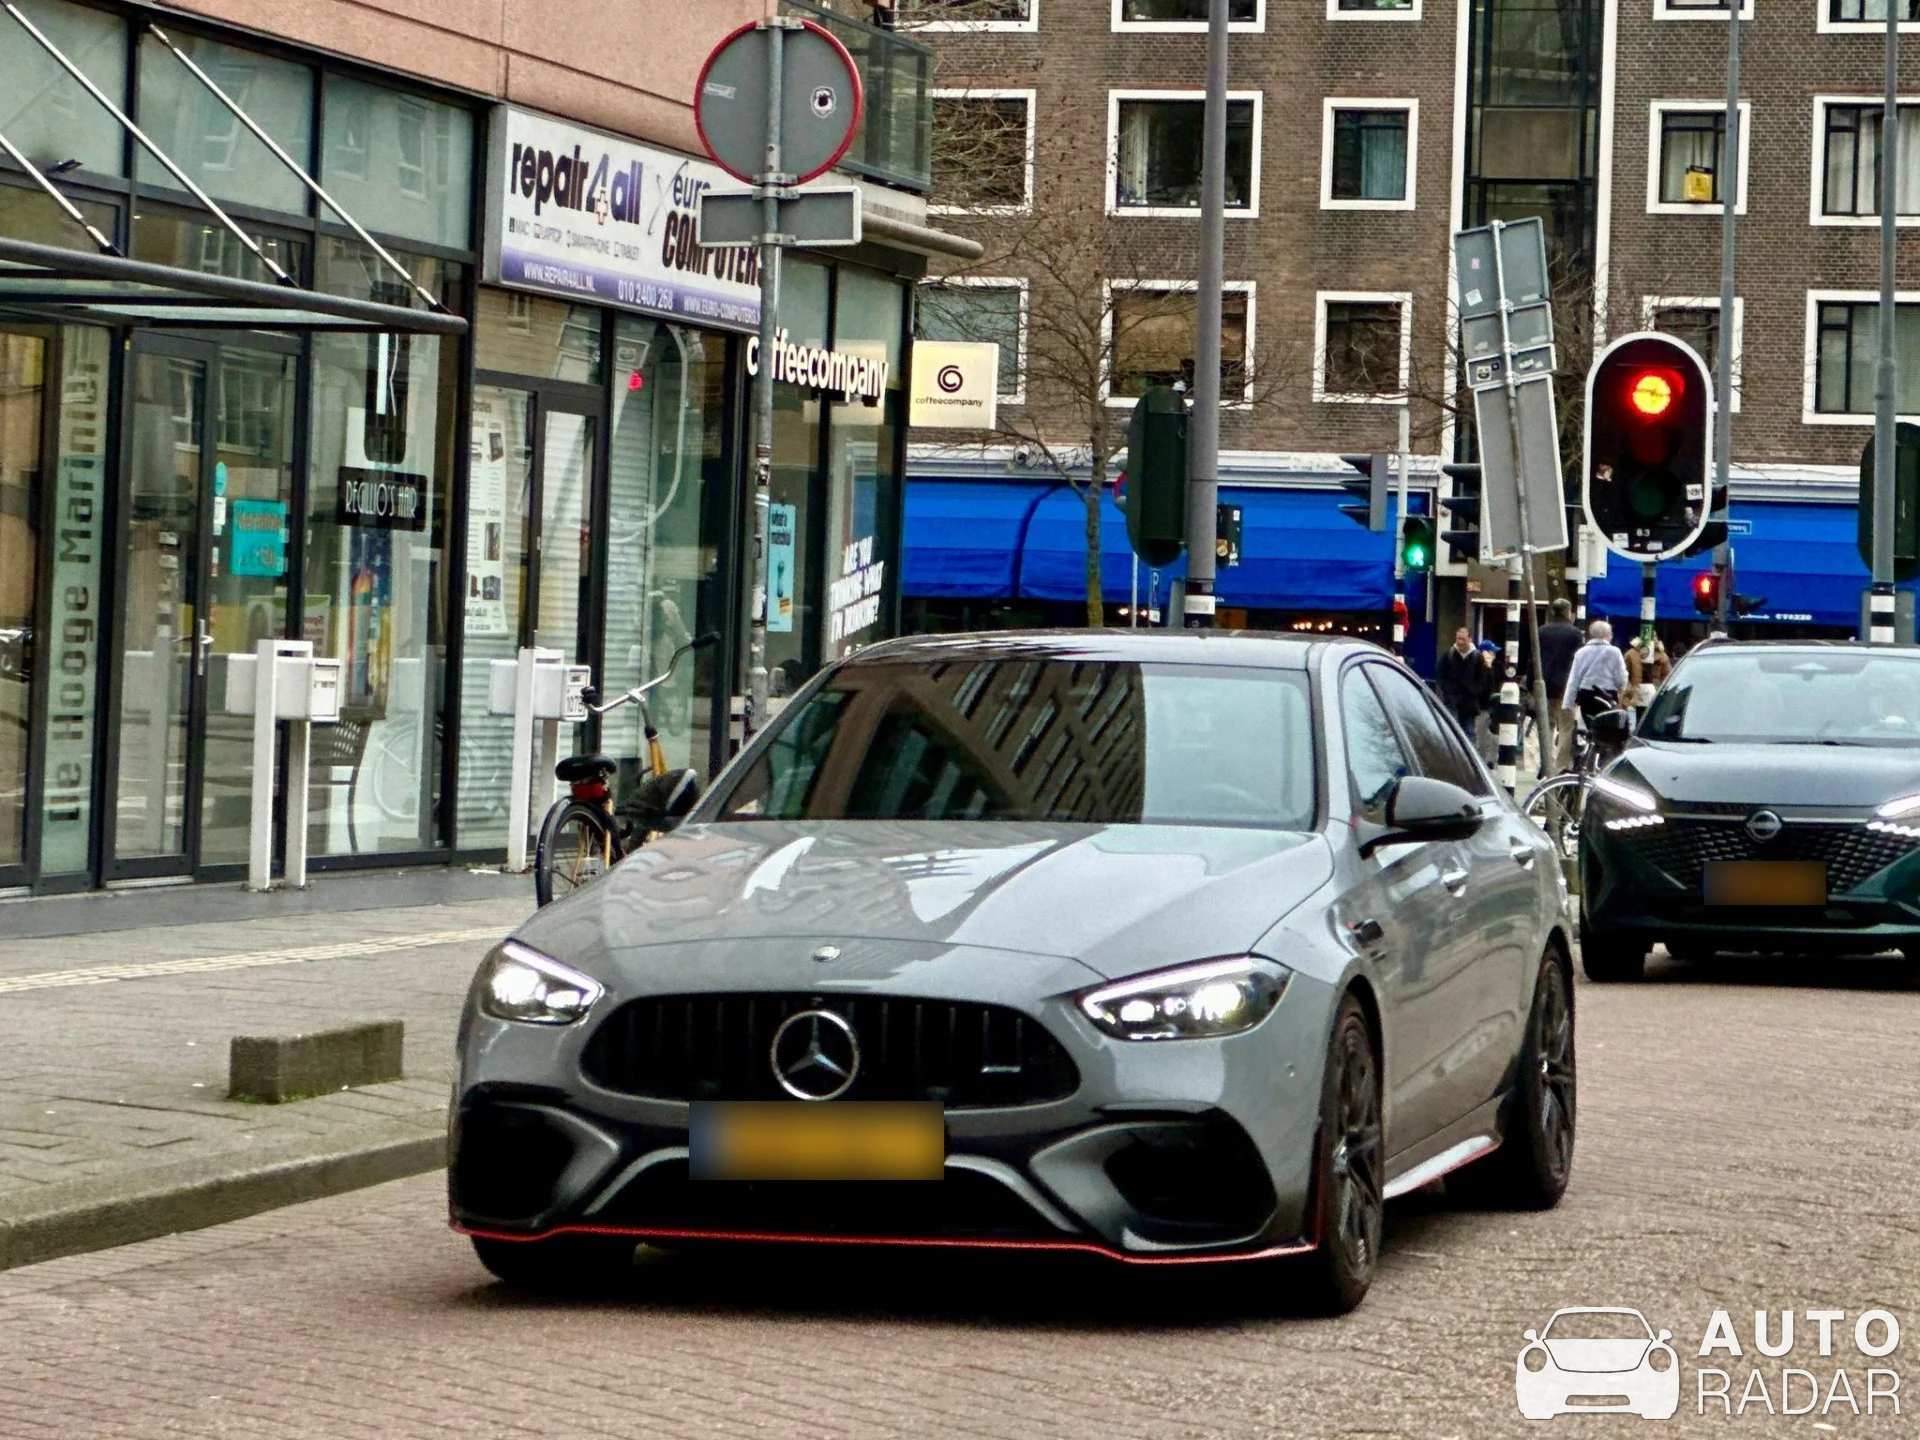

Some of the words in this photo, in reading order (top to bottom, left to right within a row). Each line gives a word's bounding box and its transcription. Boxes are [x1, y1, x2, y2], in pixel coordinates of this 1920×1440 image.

[511, 143, 643, 225] repair4all
[673, 174, 711, 210] eur
[618, 279, 634, 302] 010
[746, 326, 889, 408] cffeecompany
[915, 396, 984, 408] coffeecompany
[52, 586, 94, 740] Hooge
